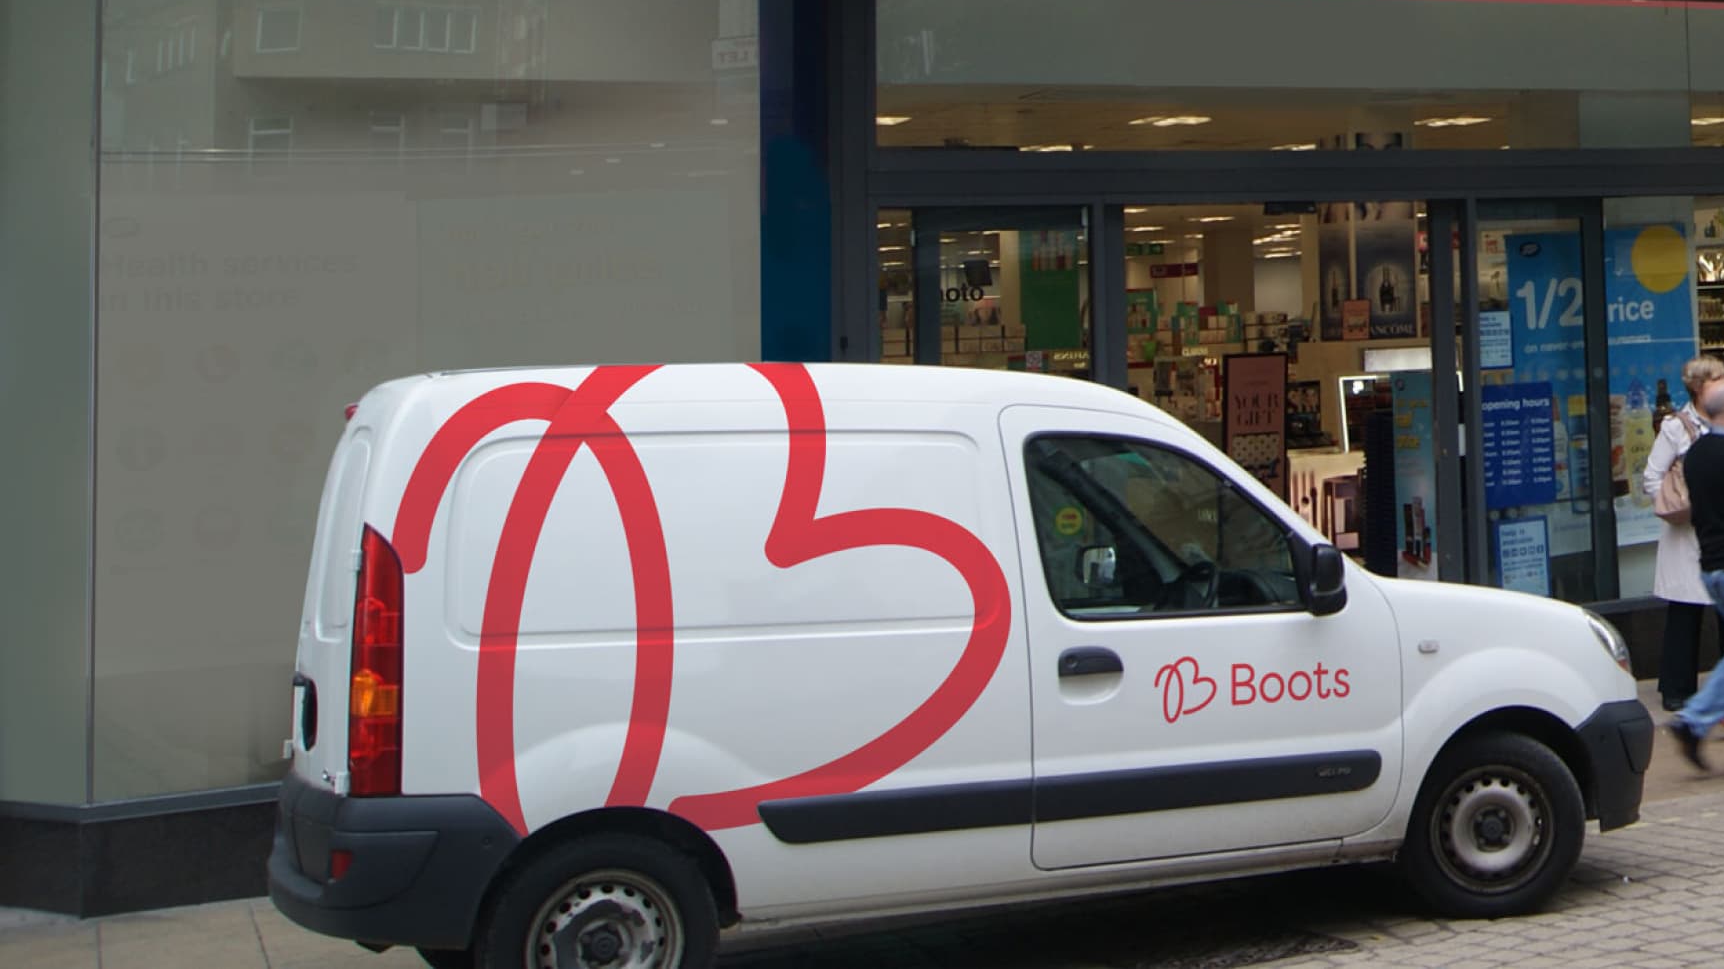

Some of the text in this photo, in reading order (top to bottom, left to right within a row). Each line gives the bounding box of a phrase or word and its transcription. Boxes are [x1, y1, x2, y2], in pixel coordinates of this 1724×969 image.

[1515, 277, 1584, 330] 1/2
[1607, 296, 1655, 323] rice
[1481, 397, 1550, 412] opening hours
[1231, 662, 1351, 706] Boots
